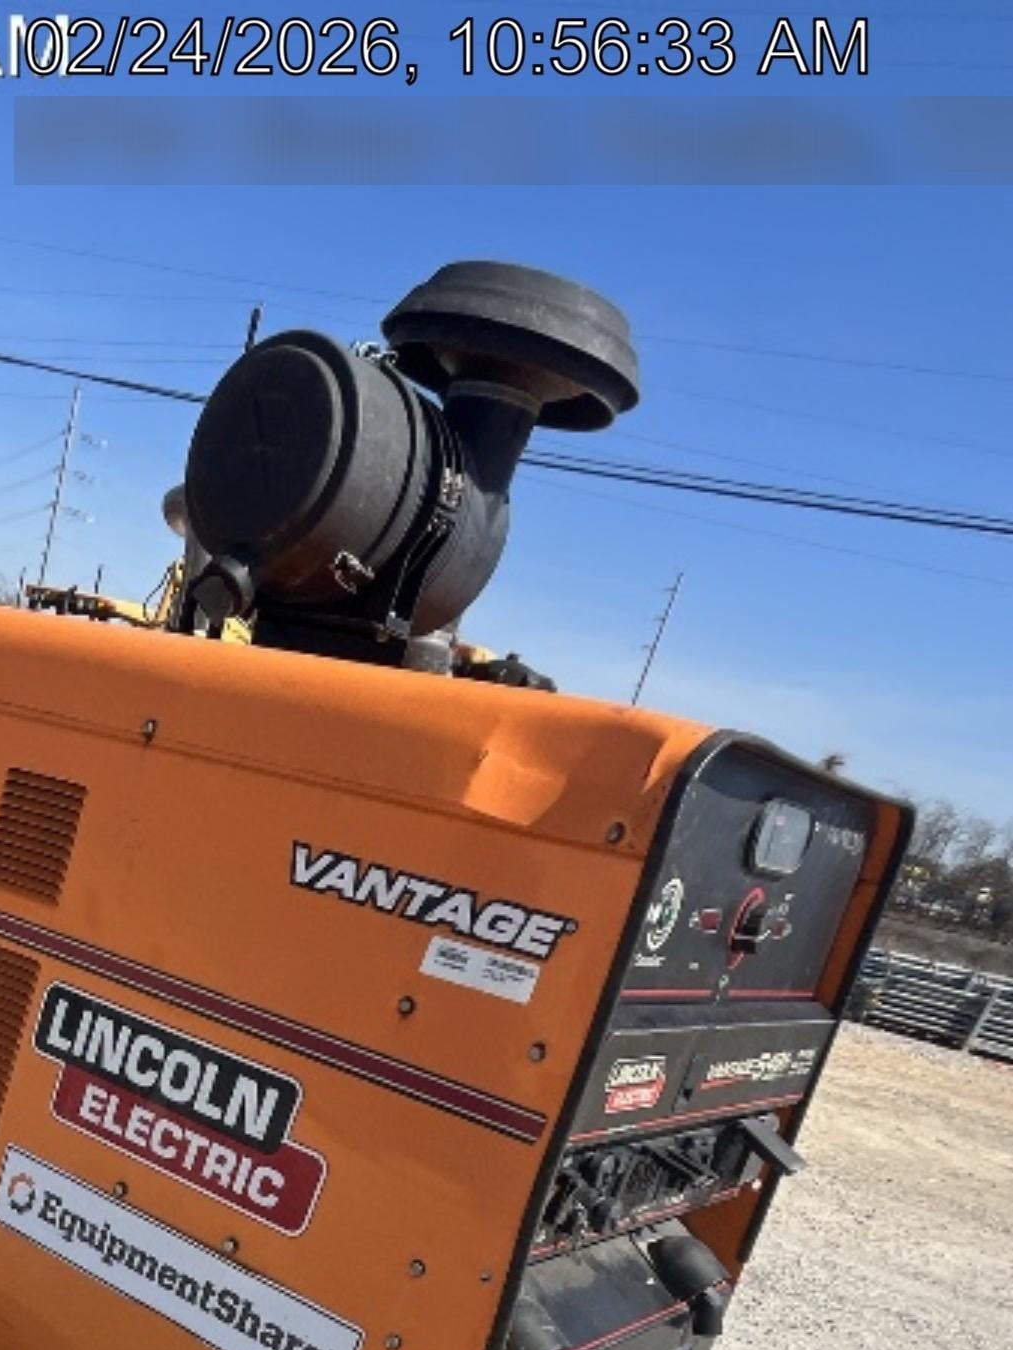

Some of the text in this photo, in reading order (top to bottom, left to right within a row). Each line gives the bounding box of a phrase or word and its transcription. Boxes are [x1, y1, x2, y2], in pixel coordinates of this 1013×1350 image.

[290, 841, 565, 959] VANTAGE
[46, 999, 279, 1141] LINCOLN
[78, 1083, 285, 1208] ELECTRIC
